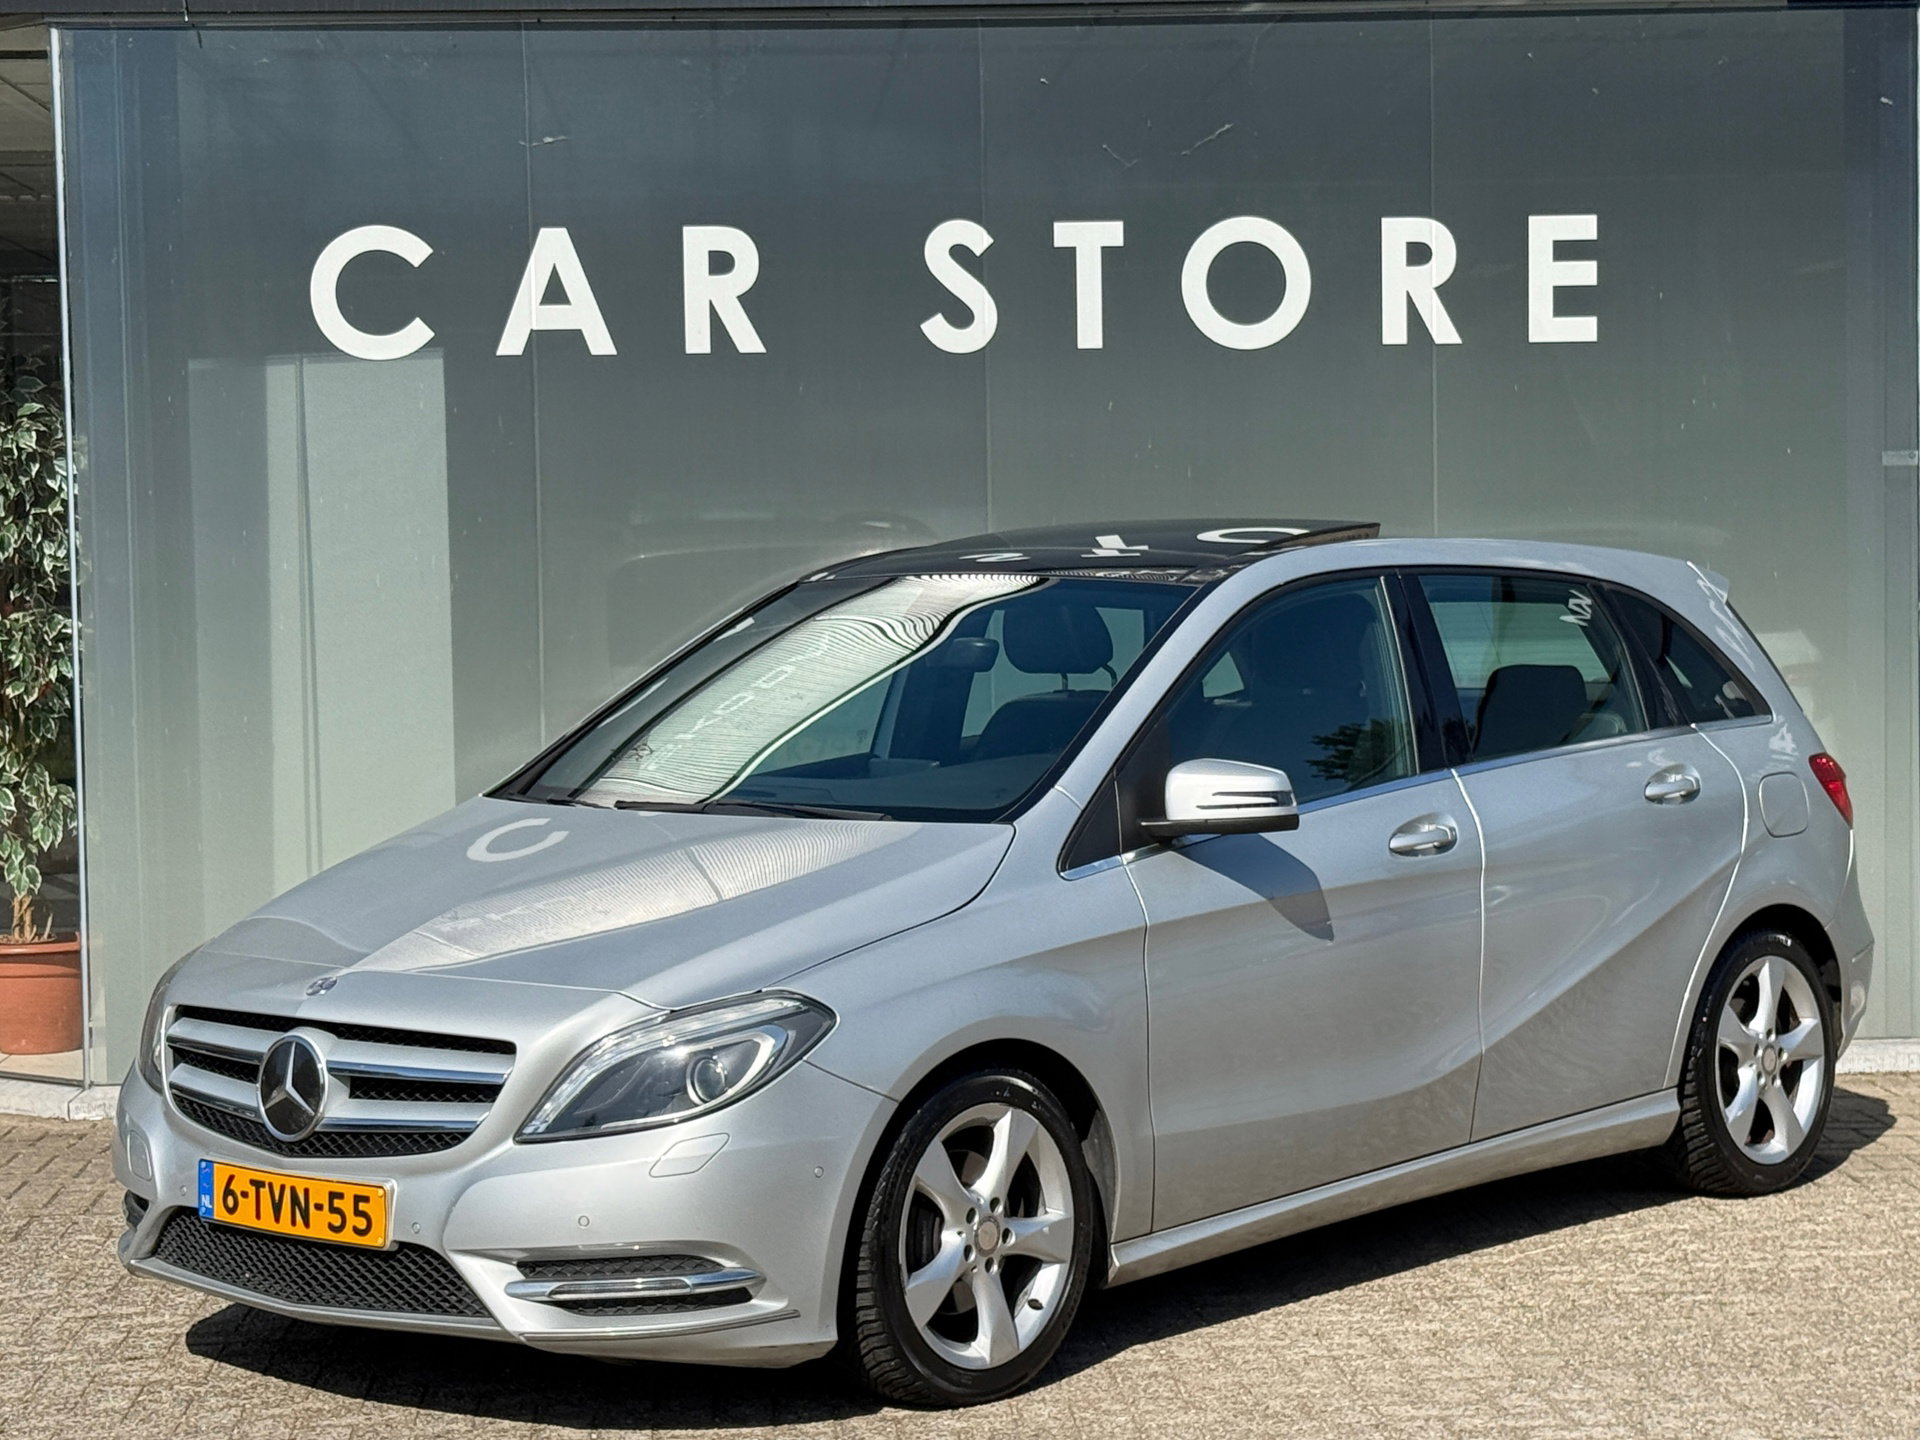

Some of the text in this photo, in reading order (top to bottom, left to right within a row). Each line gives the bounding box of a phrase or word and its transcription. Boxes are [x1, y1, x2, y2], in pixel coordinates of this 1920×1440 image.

[309, 214, 1600, 360] CAR STORE
[200, 1194, 213, 1209] NL
[222, 1174, 373, 1237] 6-TVN-55
